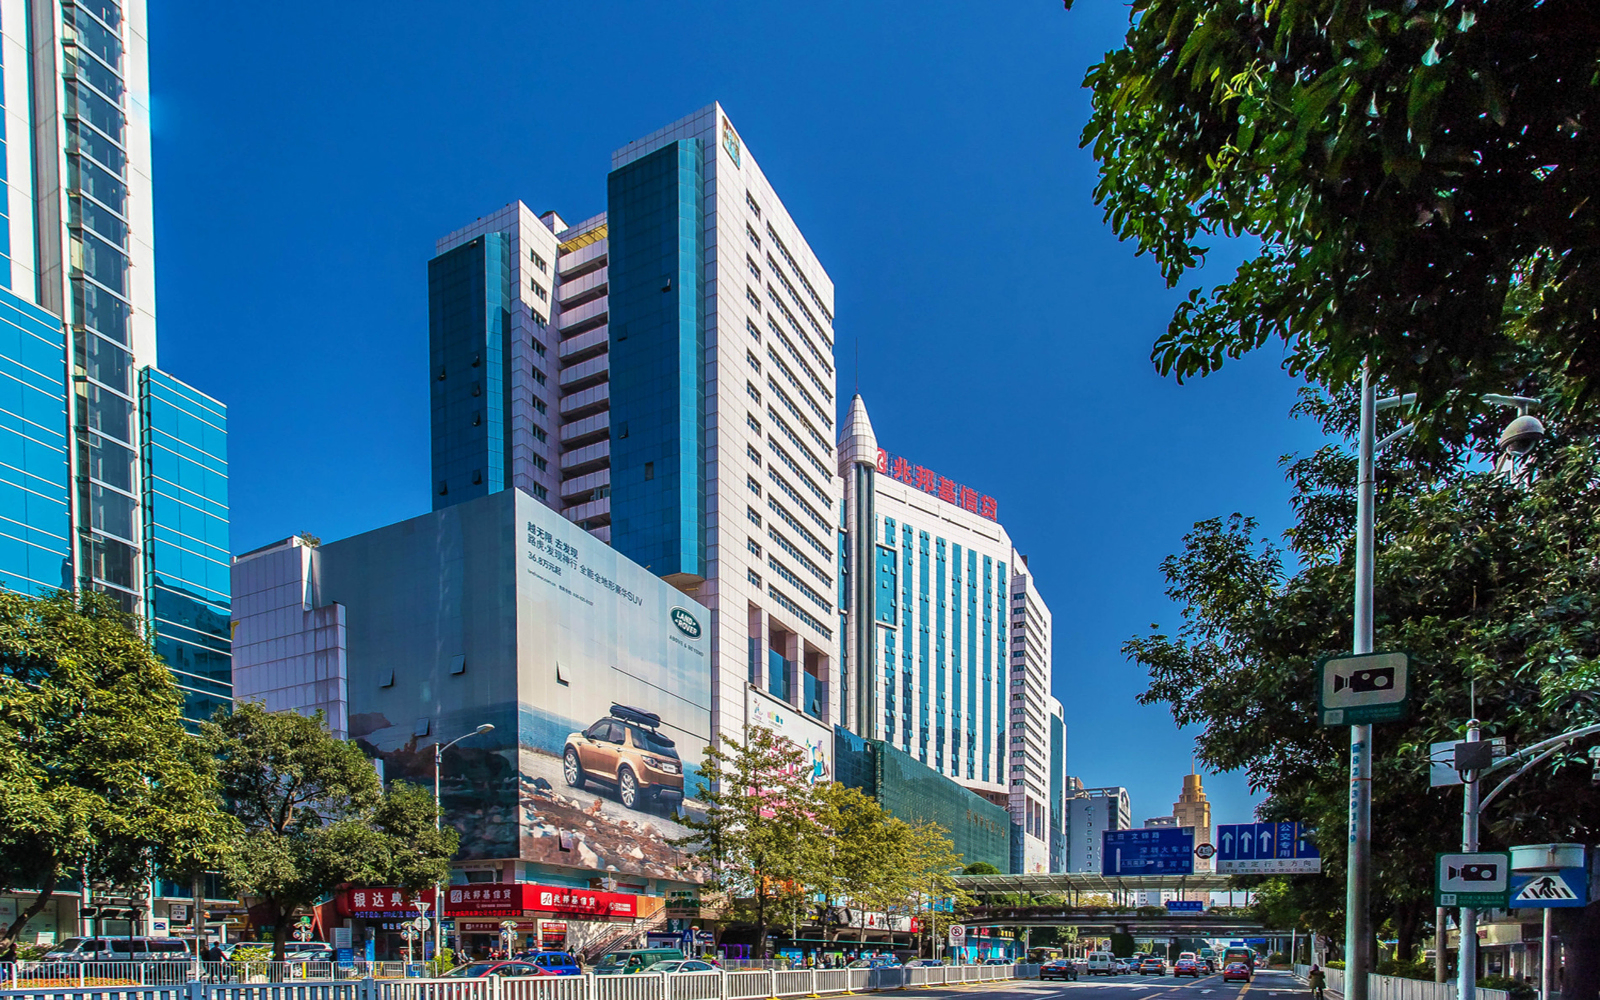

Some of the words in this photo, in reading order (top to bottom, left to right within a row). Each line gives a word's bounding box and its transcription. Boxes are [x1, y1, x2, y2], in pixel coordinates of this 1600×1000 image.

[893, 456, 997, 522] 兆邦基信贷
[676, 611, 693, 626] LAND
[677, 619, 698, 636] ROVER
[1280, 824, 1291, 857] 公交专用
